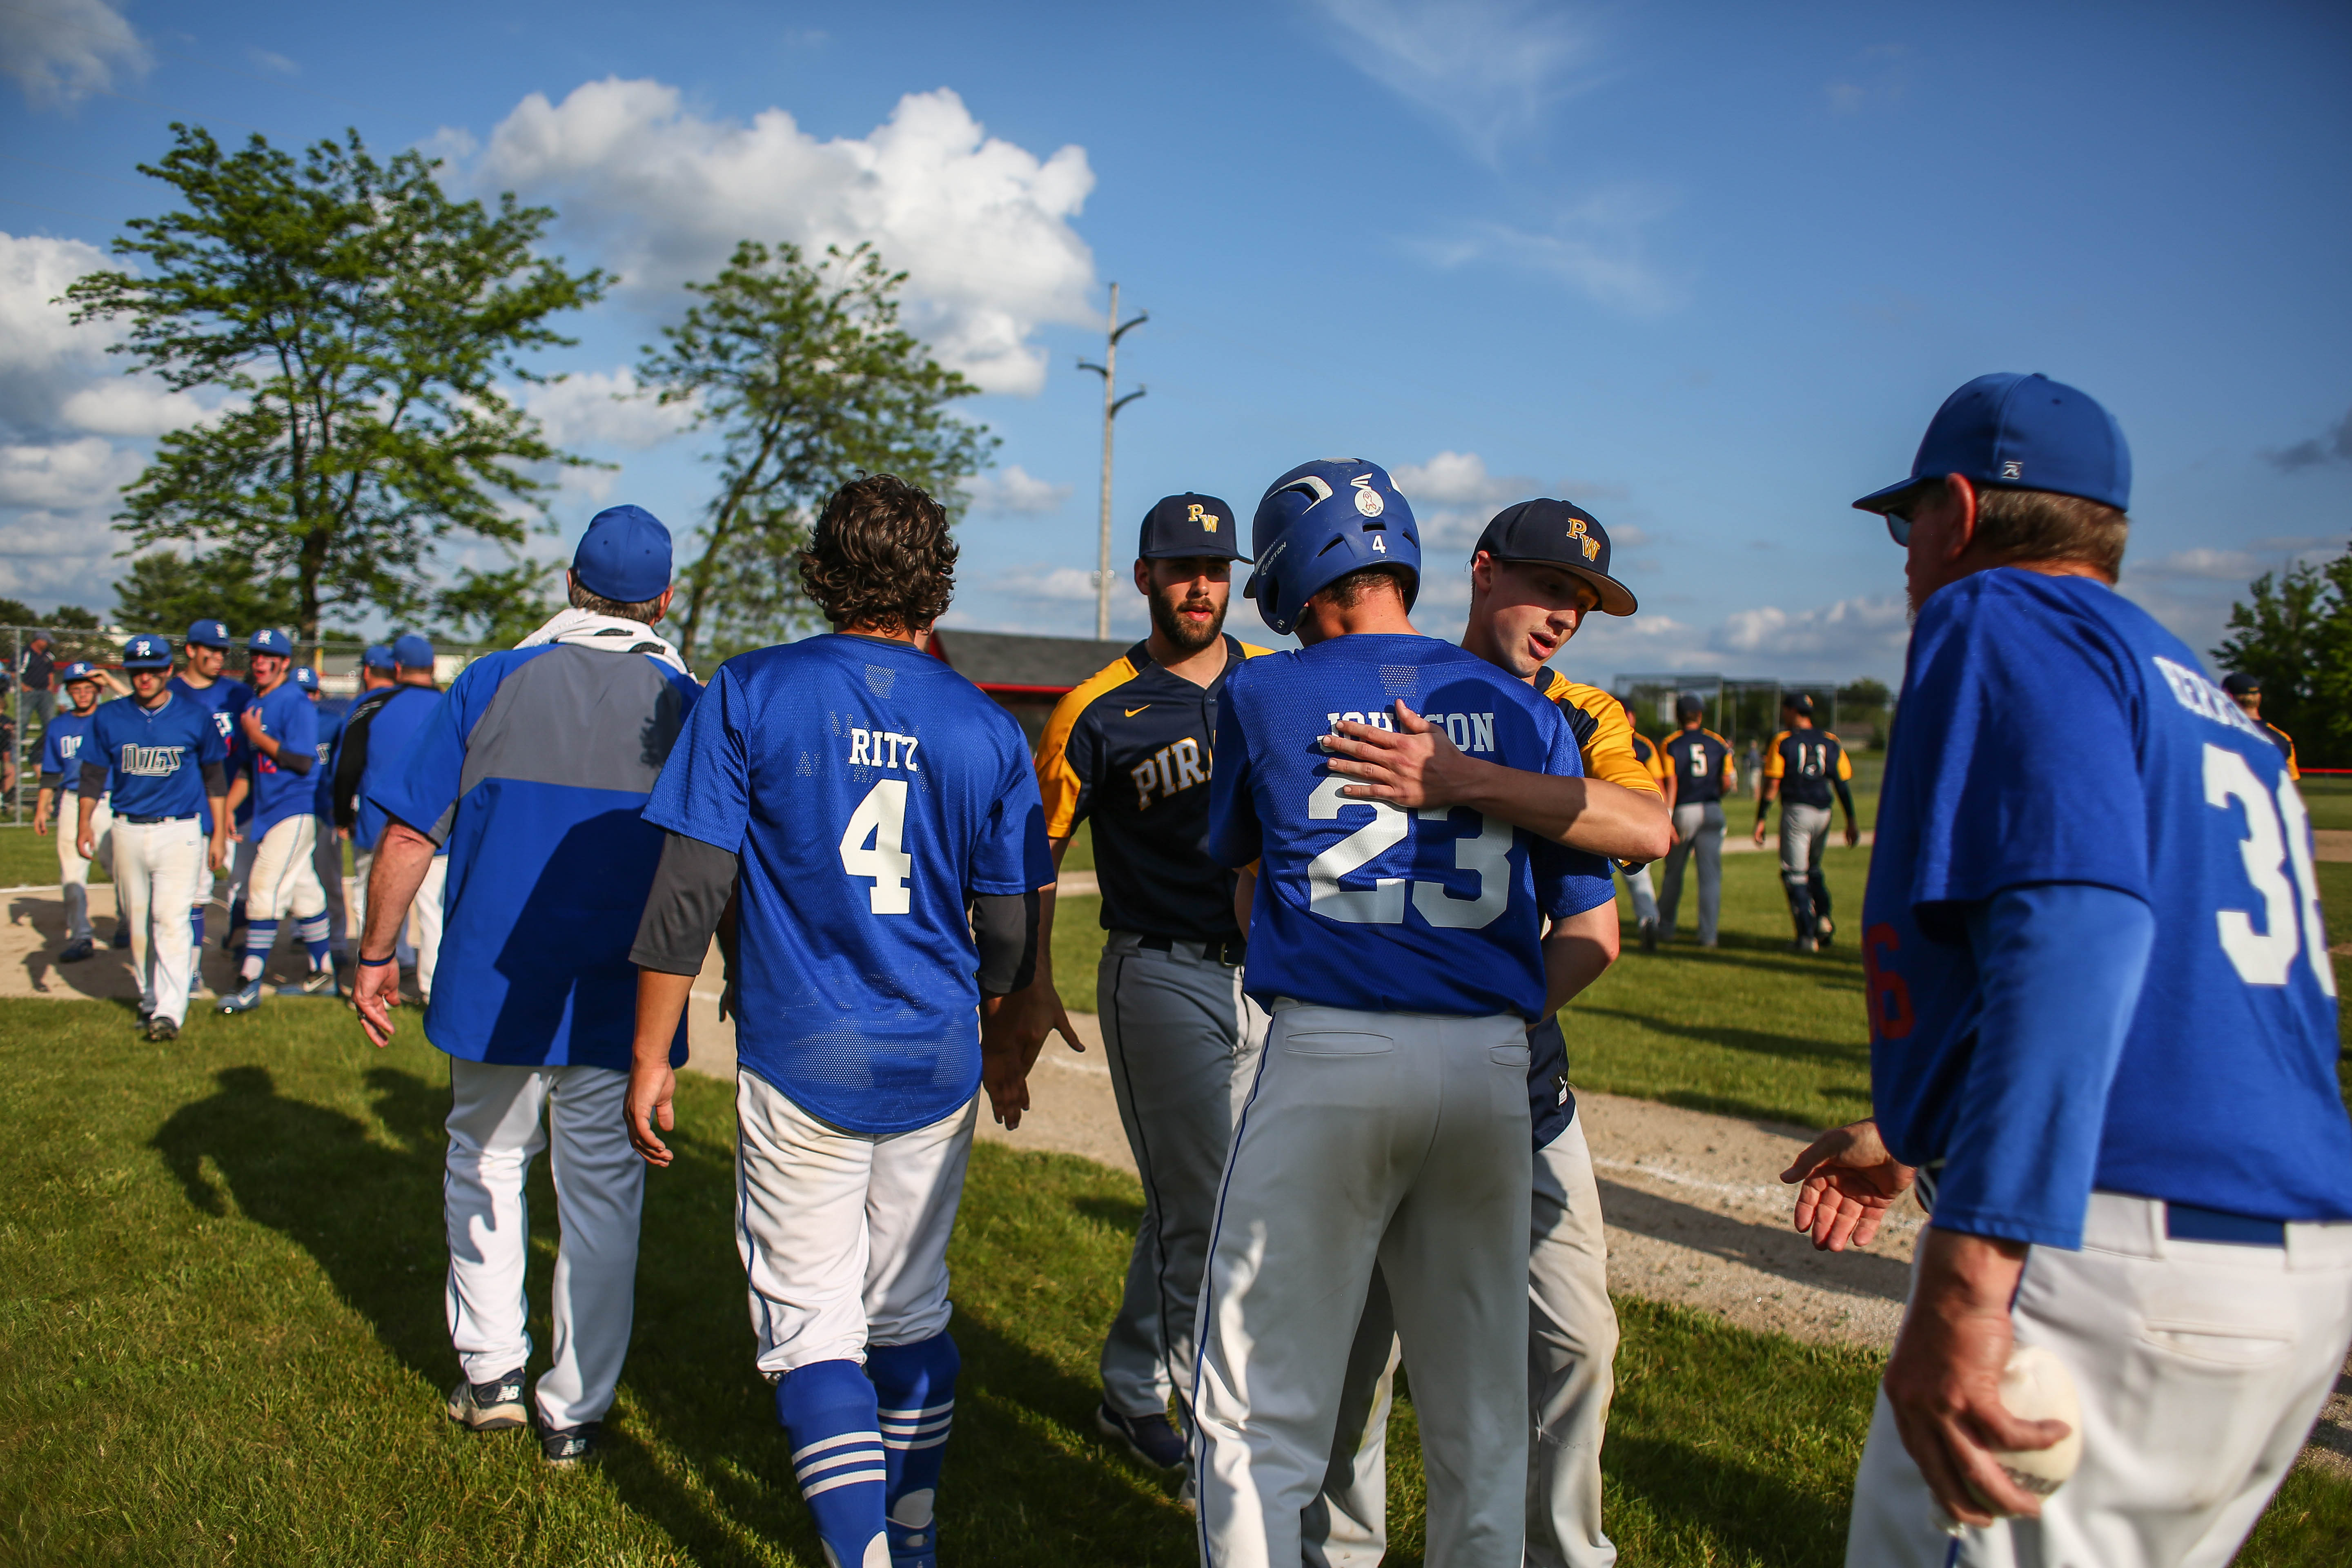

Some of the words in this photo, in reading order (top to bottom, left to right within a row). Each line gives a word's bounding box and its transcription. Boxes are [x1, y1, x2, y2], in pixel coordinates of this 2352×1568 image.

[1187, 504, 1220, 533] PW
[1566, 518, 1600, 562] PW
[1265, 541, 1286, 571] EASTON
[1372, 535, 1386, 554] 4
[849, 728, 919, 772] RITZ
[1317, 711, 1494, 753] JOHON
[1130, 737, 1213, 811] PIR
[1689, 743, 1708, 777] 5
[838, 778, 911, 915] 4
[1308, 773, 1512, 929] 23
